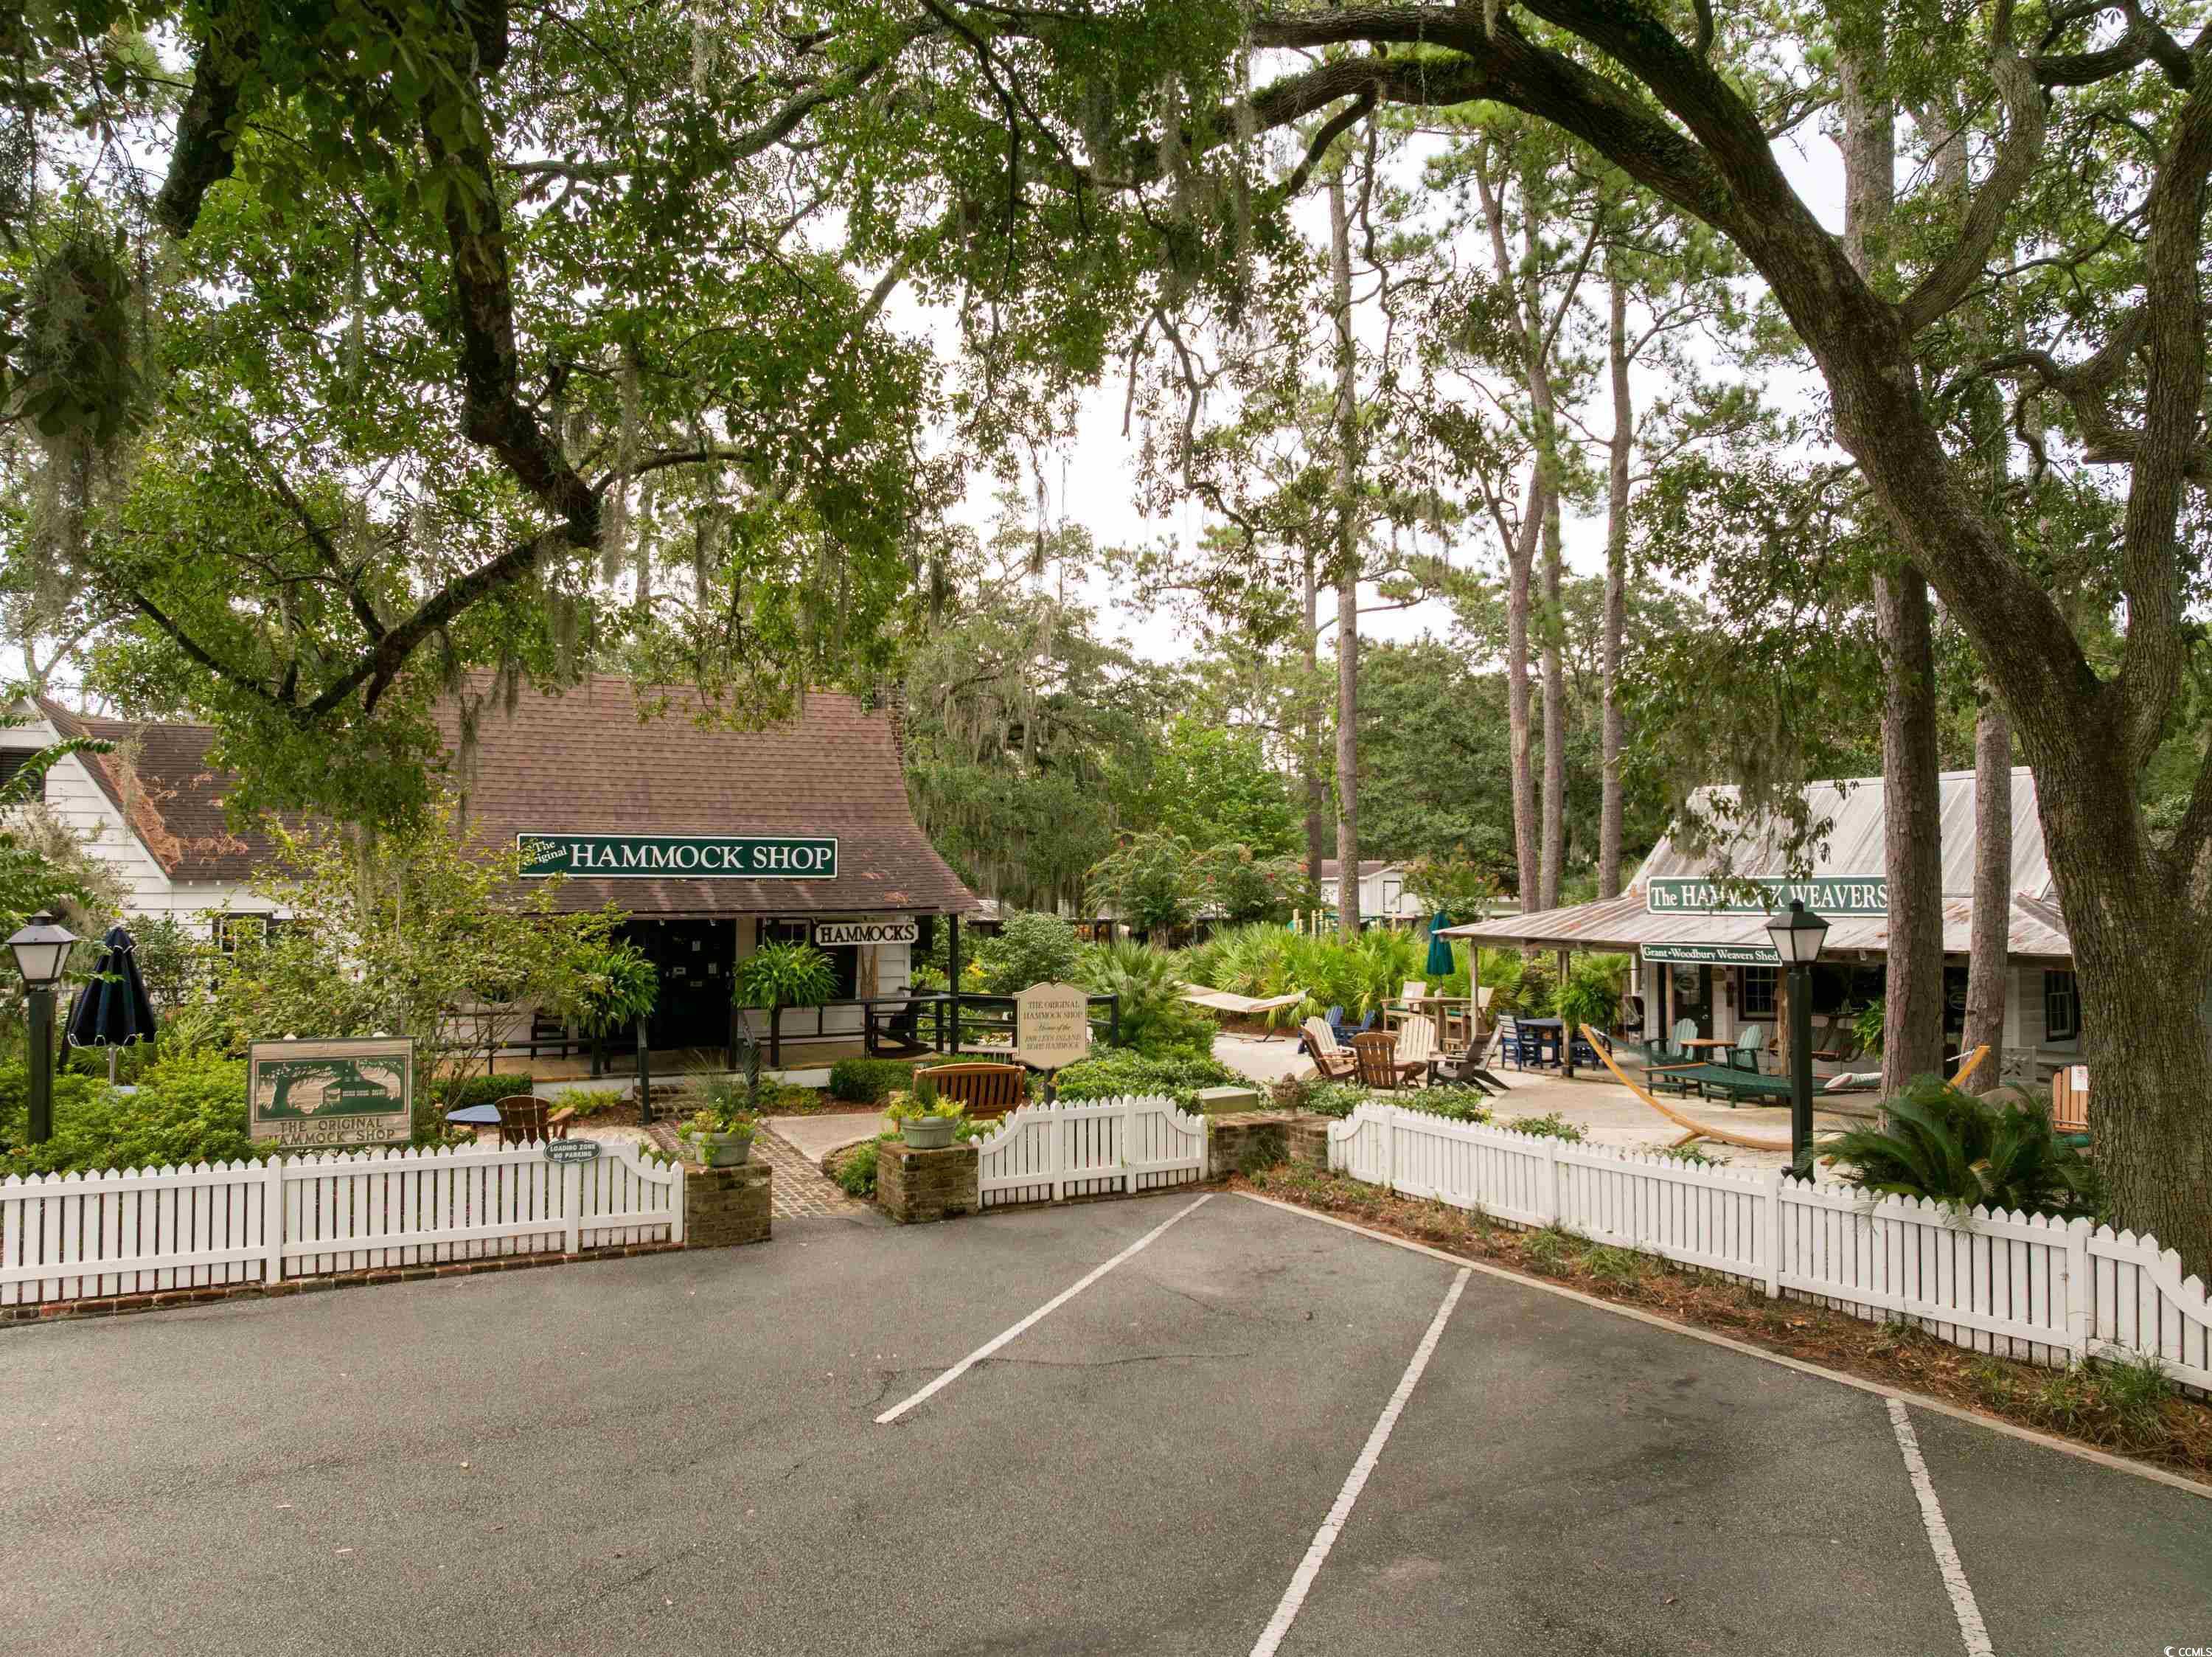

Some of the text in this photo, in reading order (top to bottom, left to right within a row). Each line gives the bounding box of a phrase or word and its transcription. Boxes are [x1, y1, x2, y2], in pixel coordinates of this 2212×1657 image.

[532, 840, 556, 852] The
[570, 844, 832, 869] HAMMOCK SHOP
[1651, 886, 1678, 907] The
[1790, 884, 1888, 909] WEAVERS
[820, 924, 914, 943] HAMMOCKS
[1717, 949, 1753, 960] Weavers
[1755, 950, 1778, 961] Shed
[1027, 1000, 1080, 1010] THE ORIGINAL
[1023, 1011, 1083, 1021] HAMMOCK SHOP
[279, 1117, 385, 1133] THE ORIGINAL
[356, 1128, 395, 1142] SHOP
